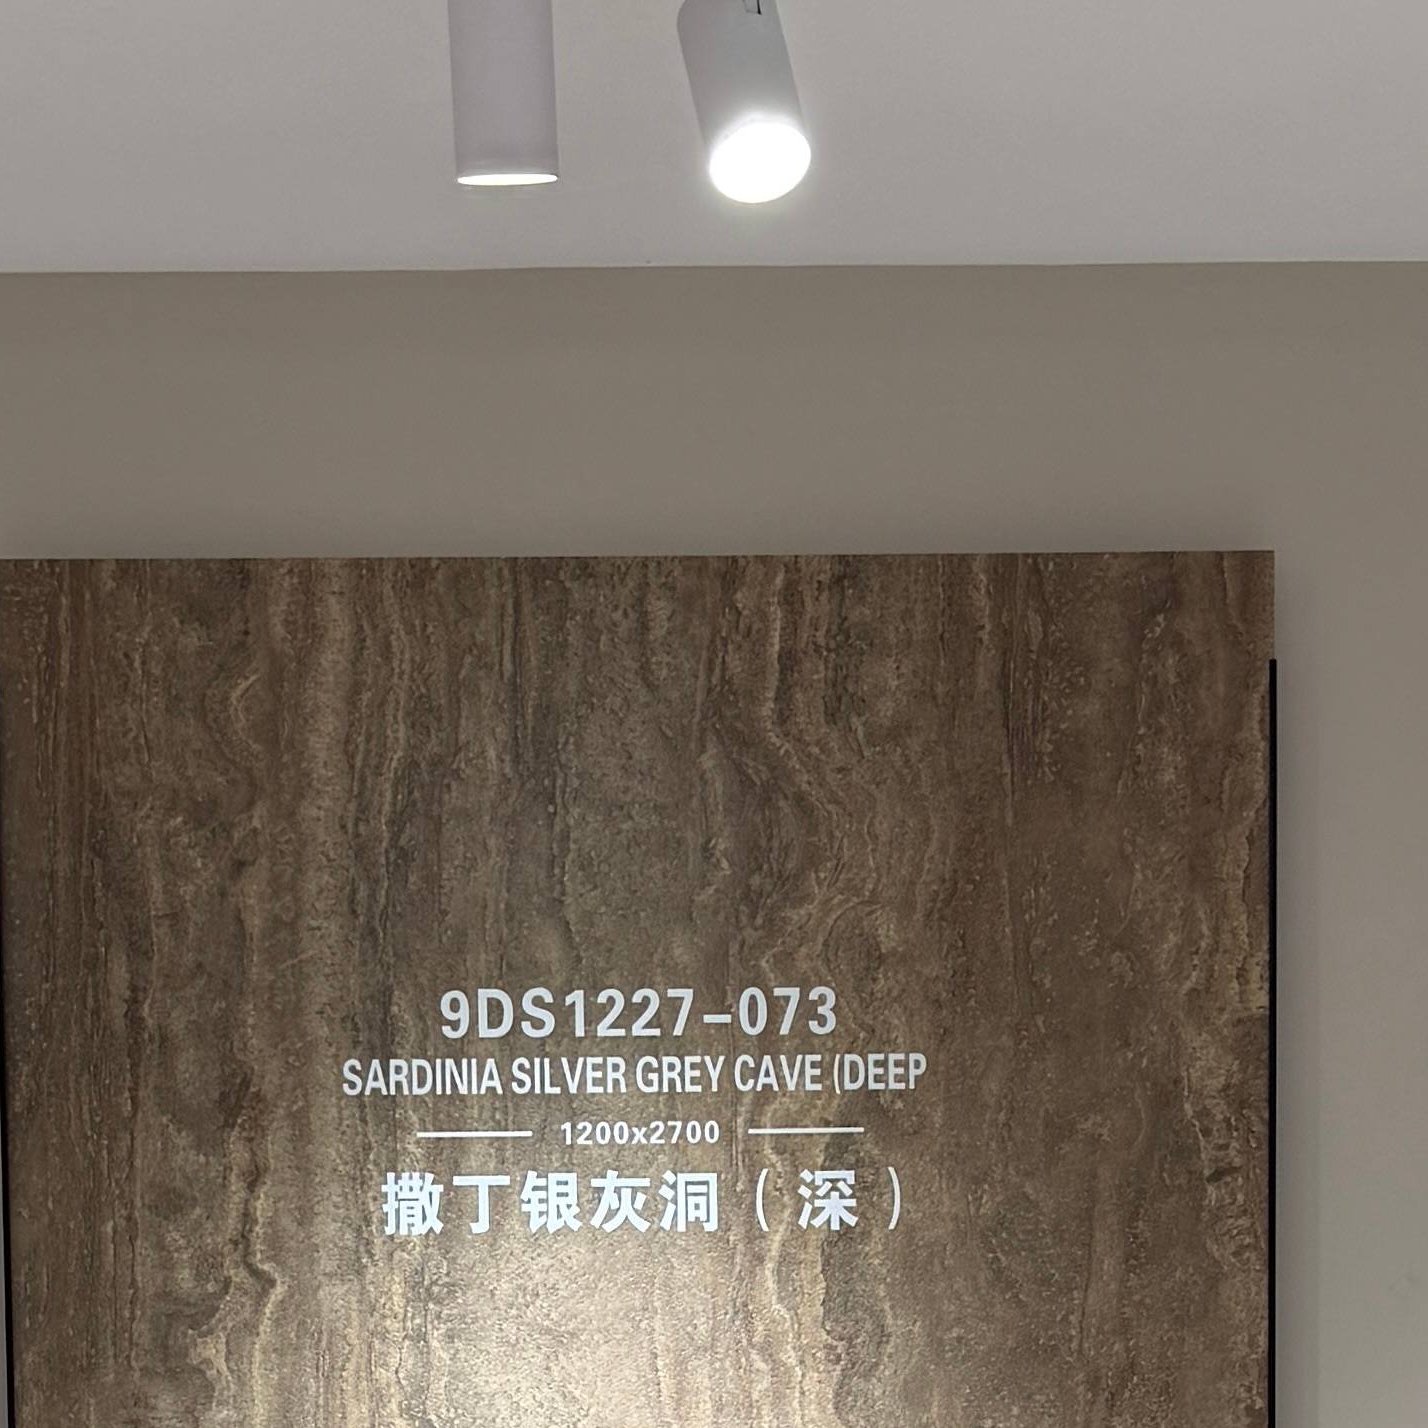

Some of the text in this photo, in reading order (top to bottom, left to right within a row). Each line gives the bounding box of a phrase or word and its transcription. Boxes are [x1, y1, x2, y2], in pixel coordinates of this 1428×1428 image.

[440, 986, 837, 1039] 9DS1227-073
[342, 1052, 928, 1096] SARDINIA SILVER GREY CAVE (DEEP
[560, 1120, 721, 1146] 1200x2700
